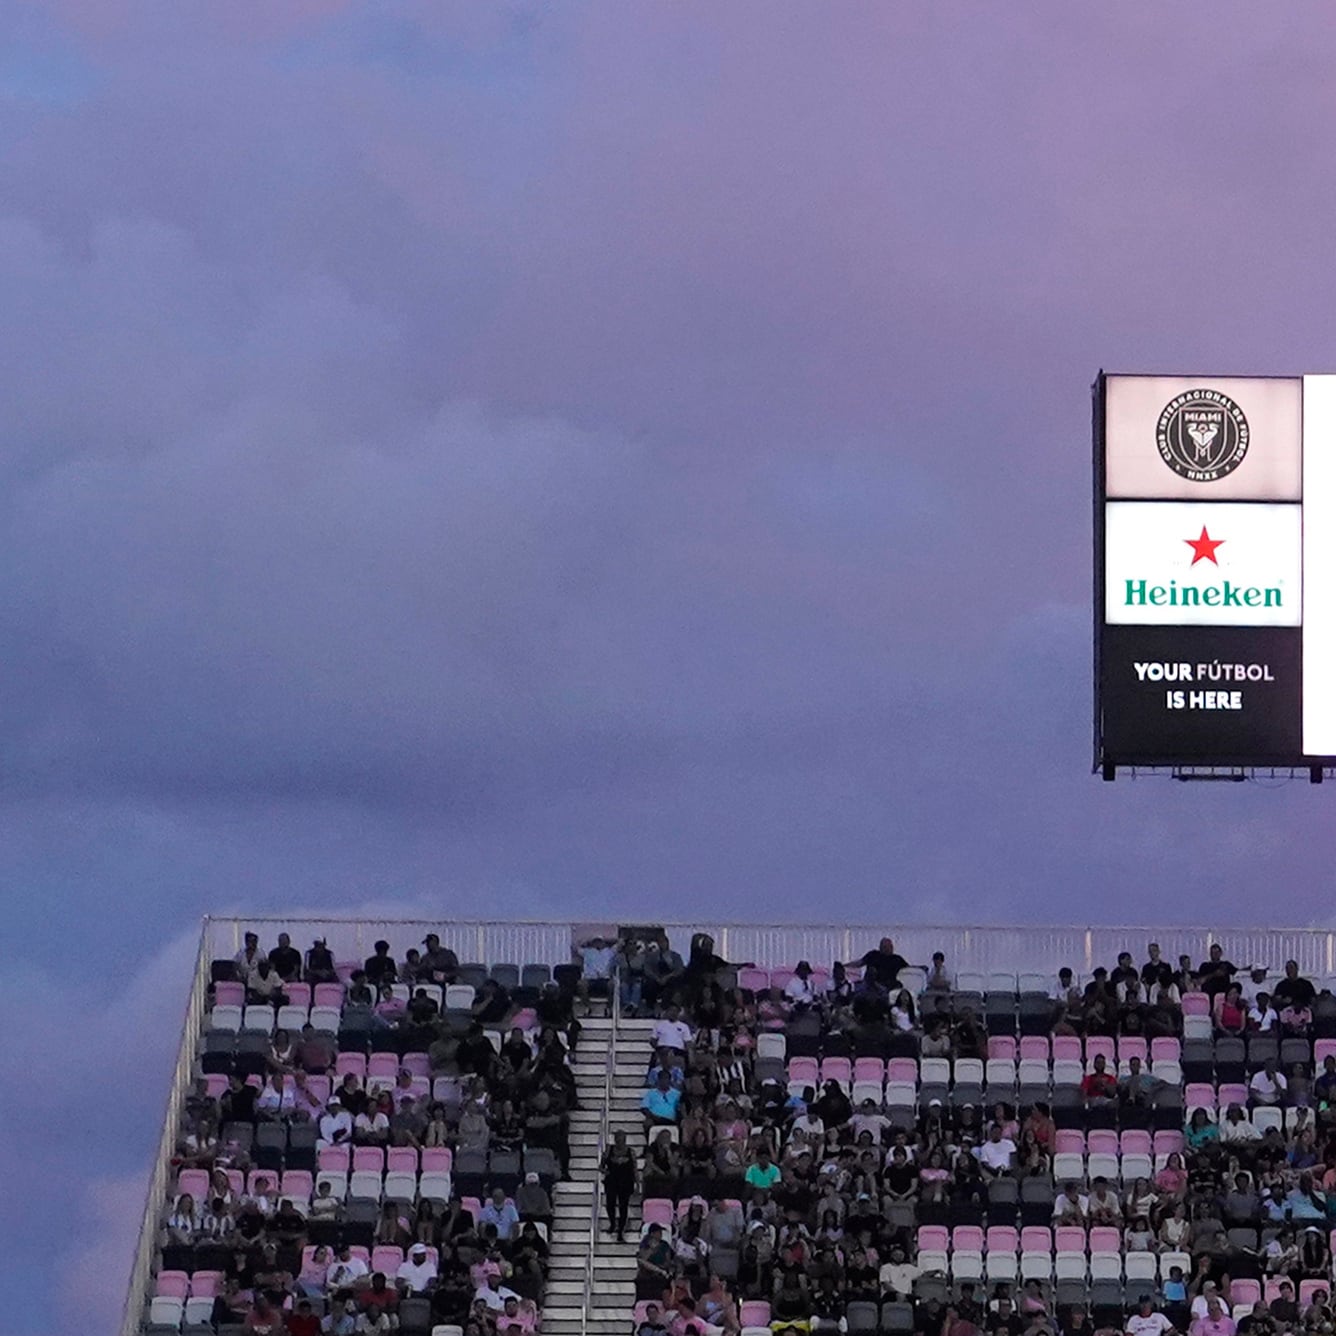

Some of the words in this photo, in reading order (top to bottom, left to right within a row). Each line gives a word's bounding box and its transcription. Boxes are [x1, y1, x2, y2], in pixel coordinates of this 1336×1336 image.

[1184, 413, 1222, 421] MIAMI
[1124, 579, 1284, 607] Heineken
[1133, 662, 1193, 682] YOUR
[1196, 659, 1275, 682] FÚTBOL
[1166, 690, 1186, 710] IS
[1189, 690, 1243, 710] HERE
